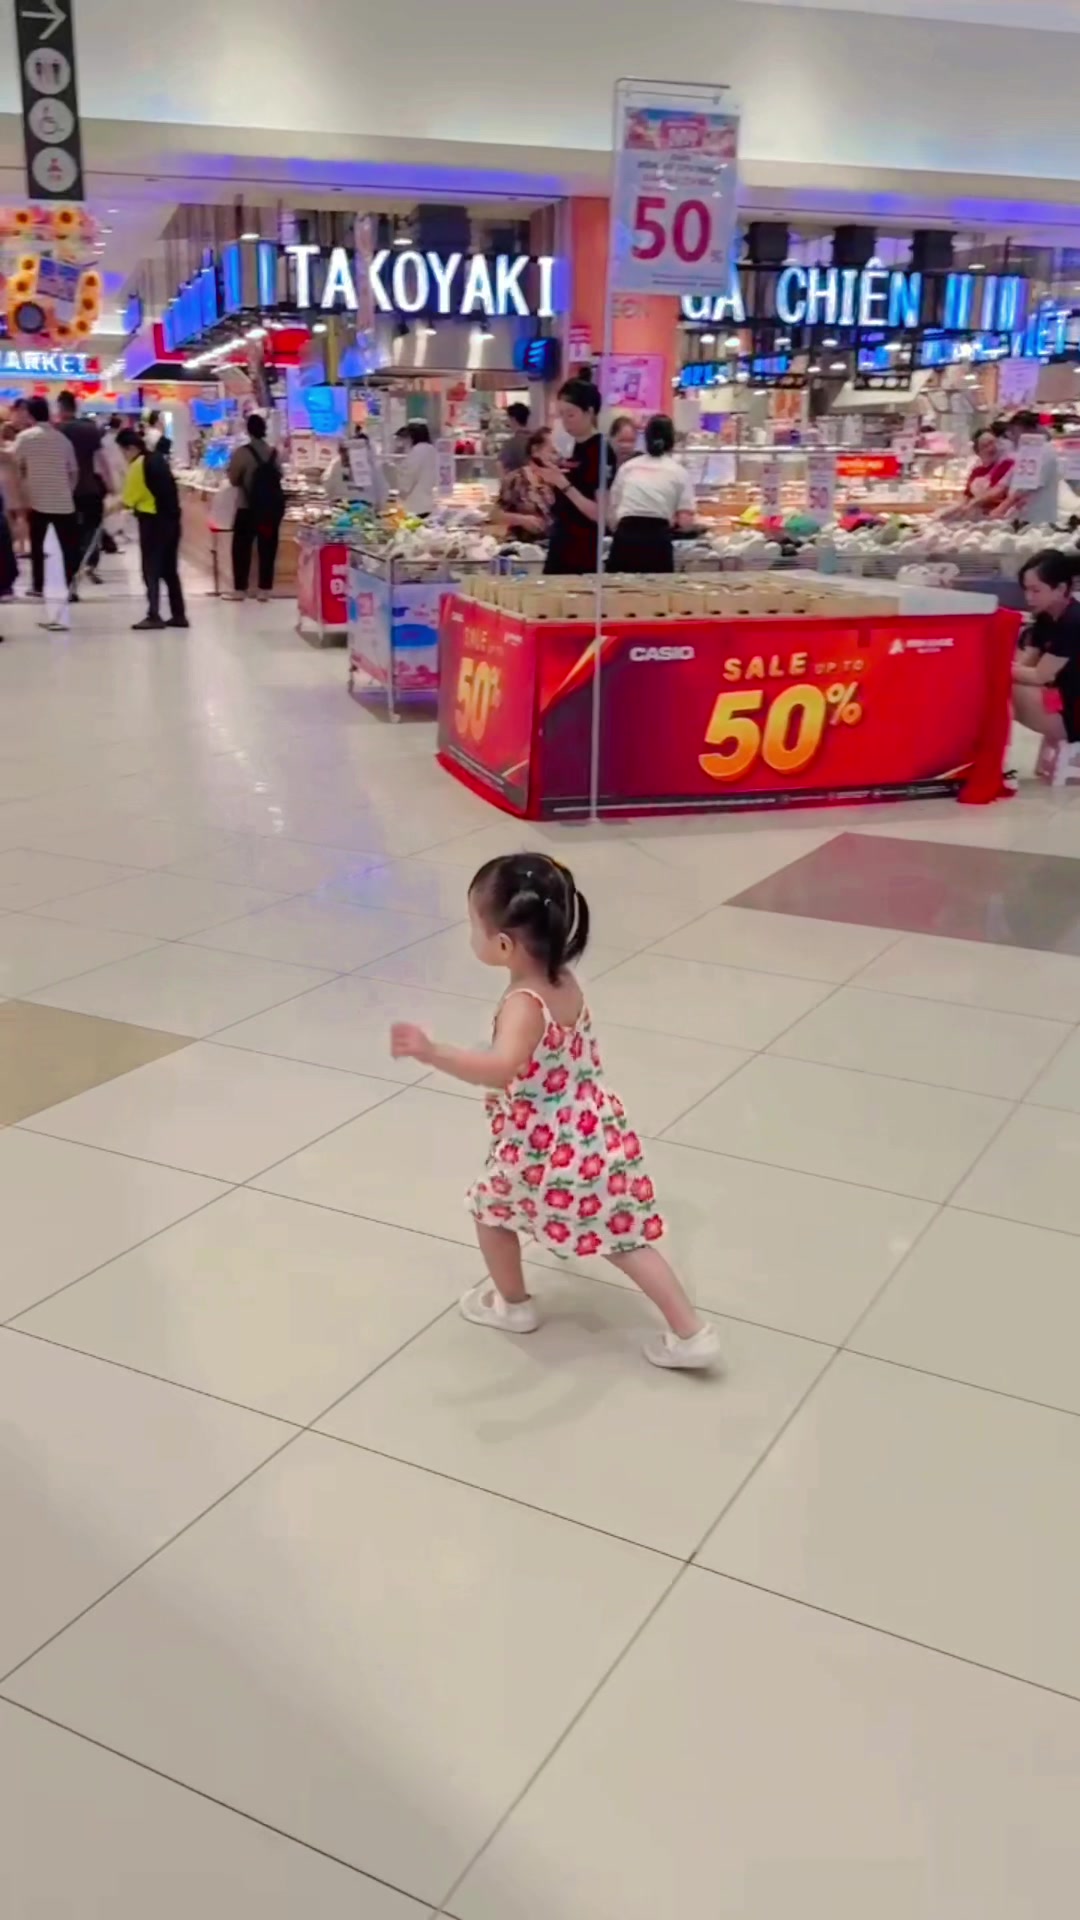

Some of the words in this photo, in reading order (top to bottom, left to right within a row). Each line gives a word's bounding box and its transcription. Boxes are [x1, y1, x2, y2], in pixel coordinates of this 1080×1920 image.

[284, 244, 556, 318] TAKOYAKI
[775, 256, 923, 328] CHIÊN
[0, 350, 88, 373] ARKET
[629, 646, 696, 662] CASIO
[722, 651, 808, 682] SALE
[697, 680, 863, 783] 50%
